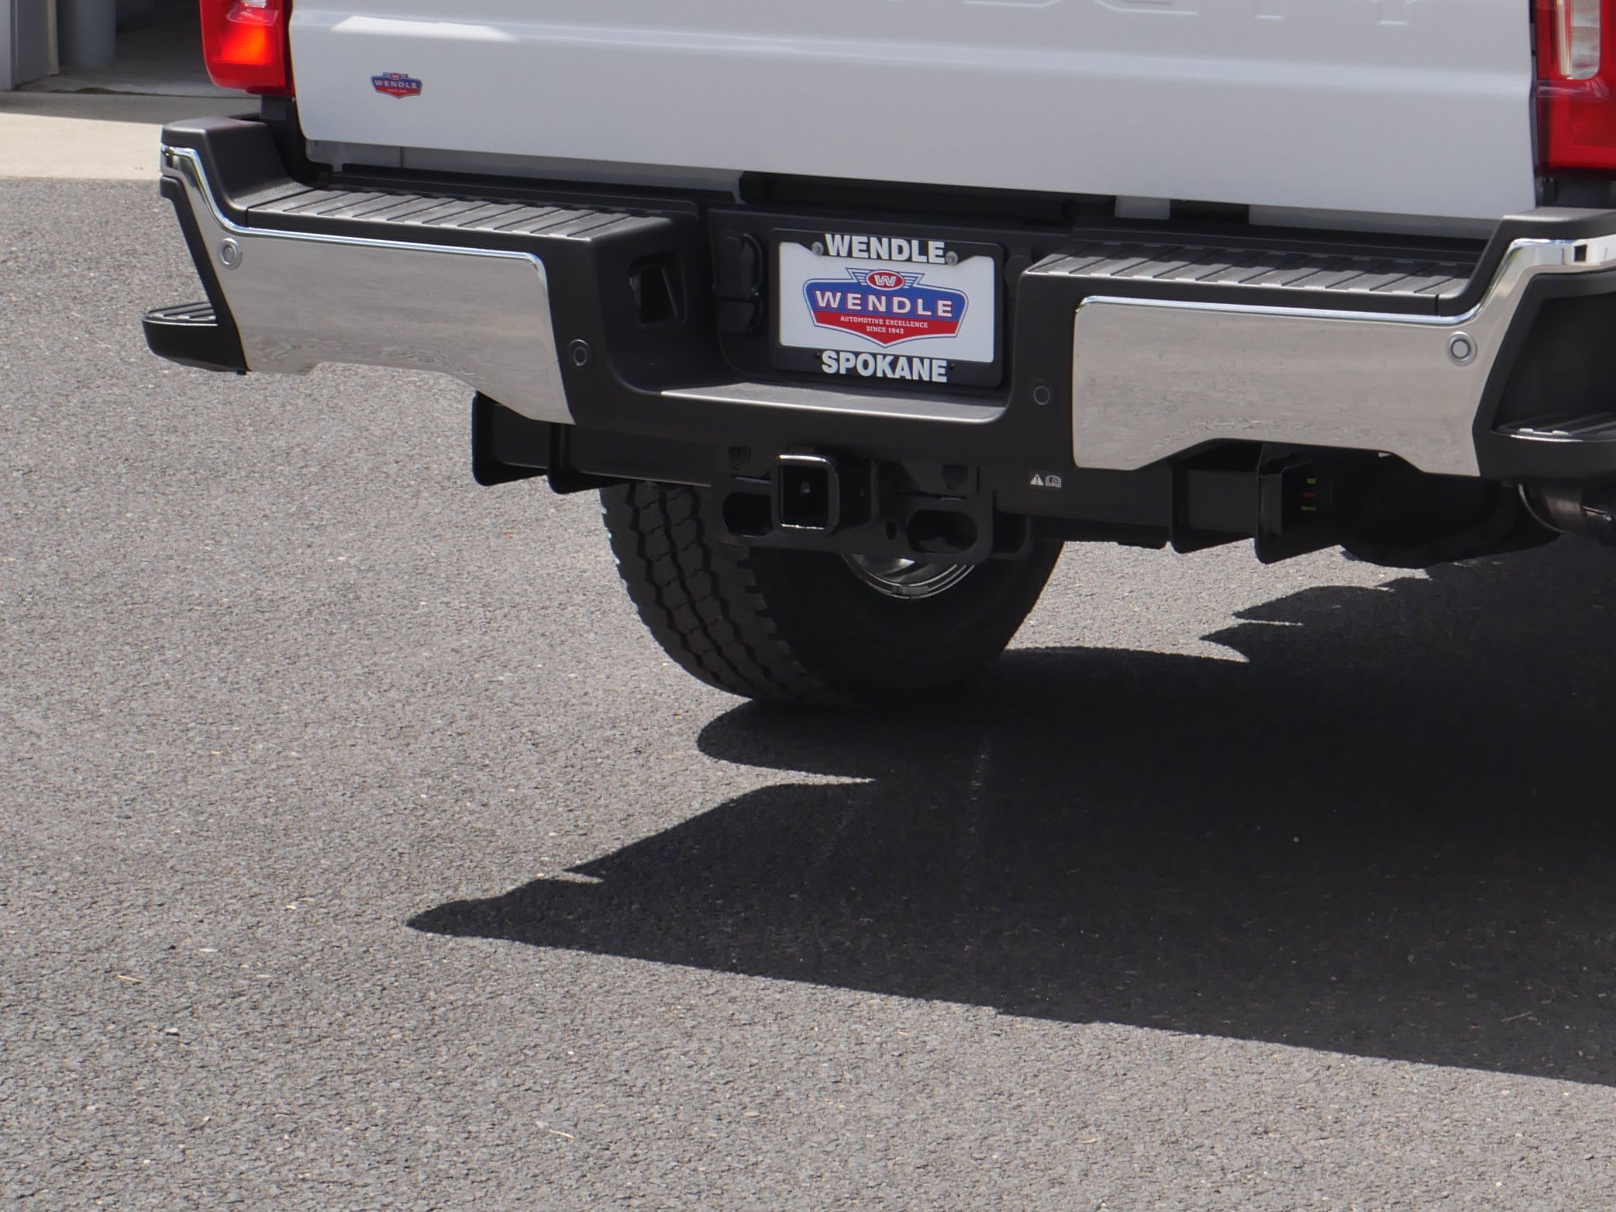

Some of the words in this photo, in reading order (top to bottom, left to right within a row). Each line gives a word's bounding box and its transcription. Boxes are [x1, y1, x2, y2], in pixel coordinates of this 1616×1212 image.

[374, 80, 418, 89] WENDLE
[825, 234, 946, 264] WENDLE
[814, 290, 953, 317] WENDLE
[840, 316, 884, 325] AUTOMOTIVE
[885, 319, 928, 328] EXCELLENCE
[821, 350, 948, 383] SPOKANE
